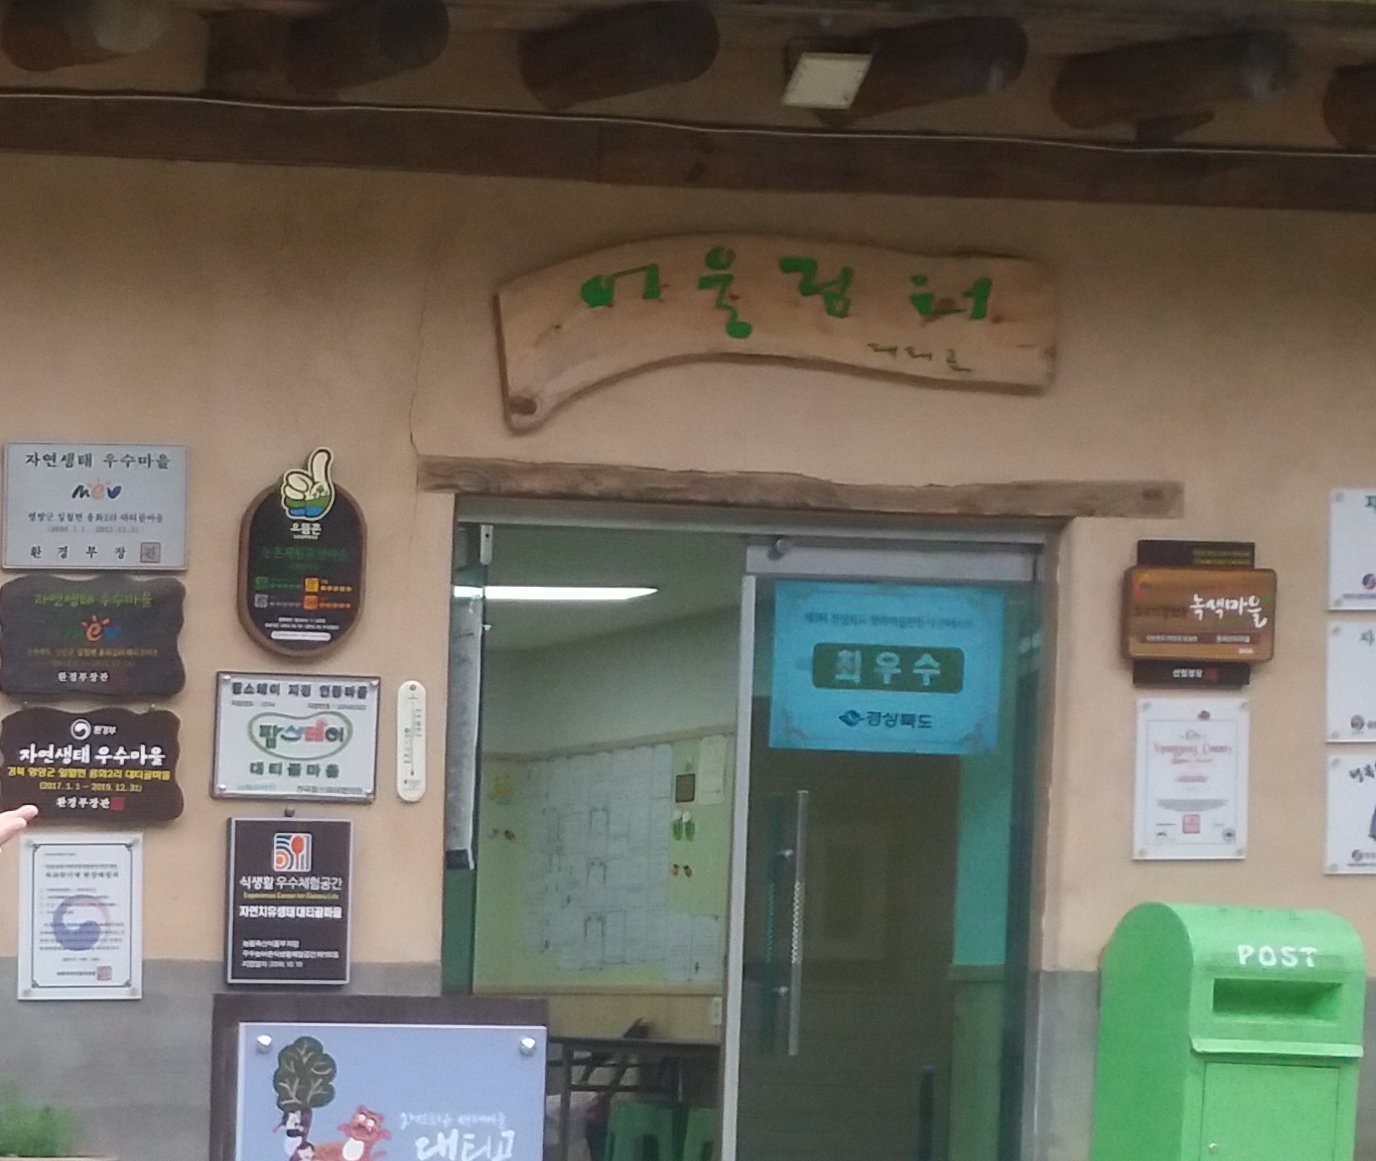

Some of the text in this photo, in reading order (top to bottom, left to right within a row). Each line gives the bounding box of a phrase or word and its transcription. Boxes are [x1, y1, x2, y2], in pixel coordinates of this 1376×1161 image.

[25, 451, 171, 470] 자연생태 우수마을
[1189, 593, 1268, 629] 녹색마을
[834, 649, 942, 687] 최우수
[866, 710, 933, 730] 경상북도
[18, 743, 166, 766] 자연생태 우수마을
[240, 875, 274, 891] 식생활
[1236, 944, 1318, 968] POST
